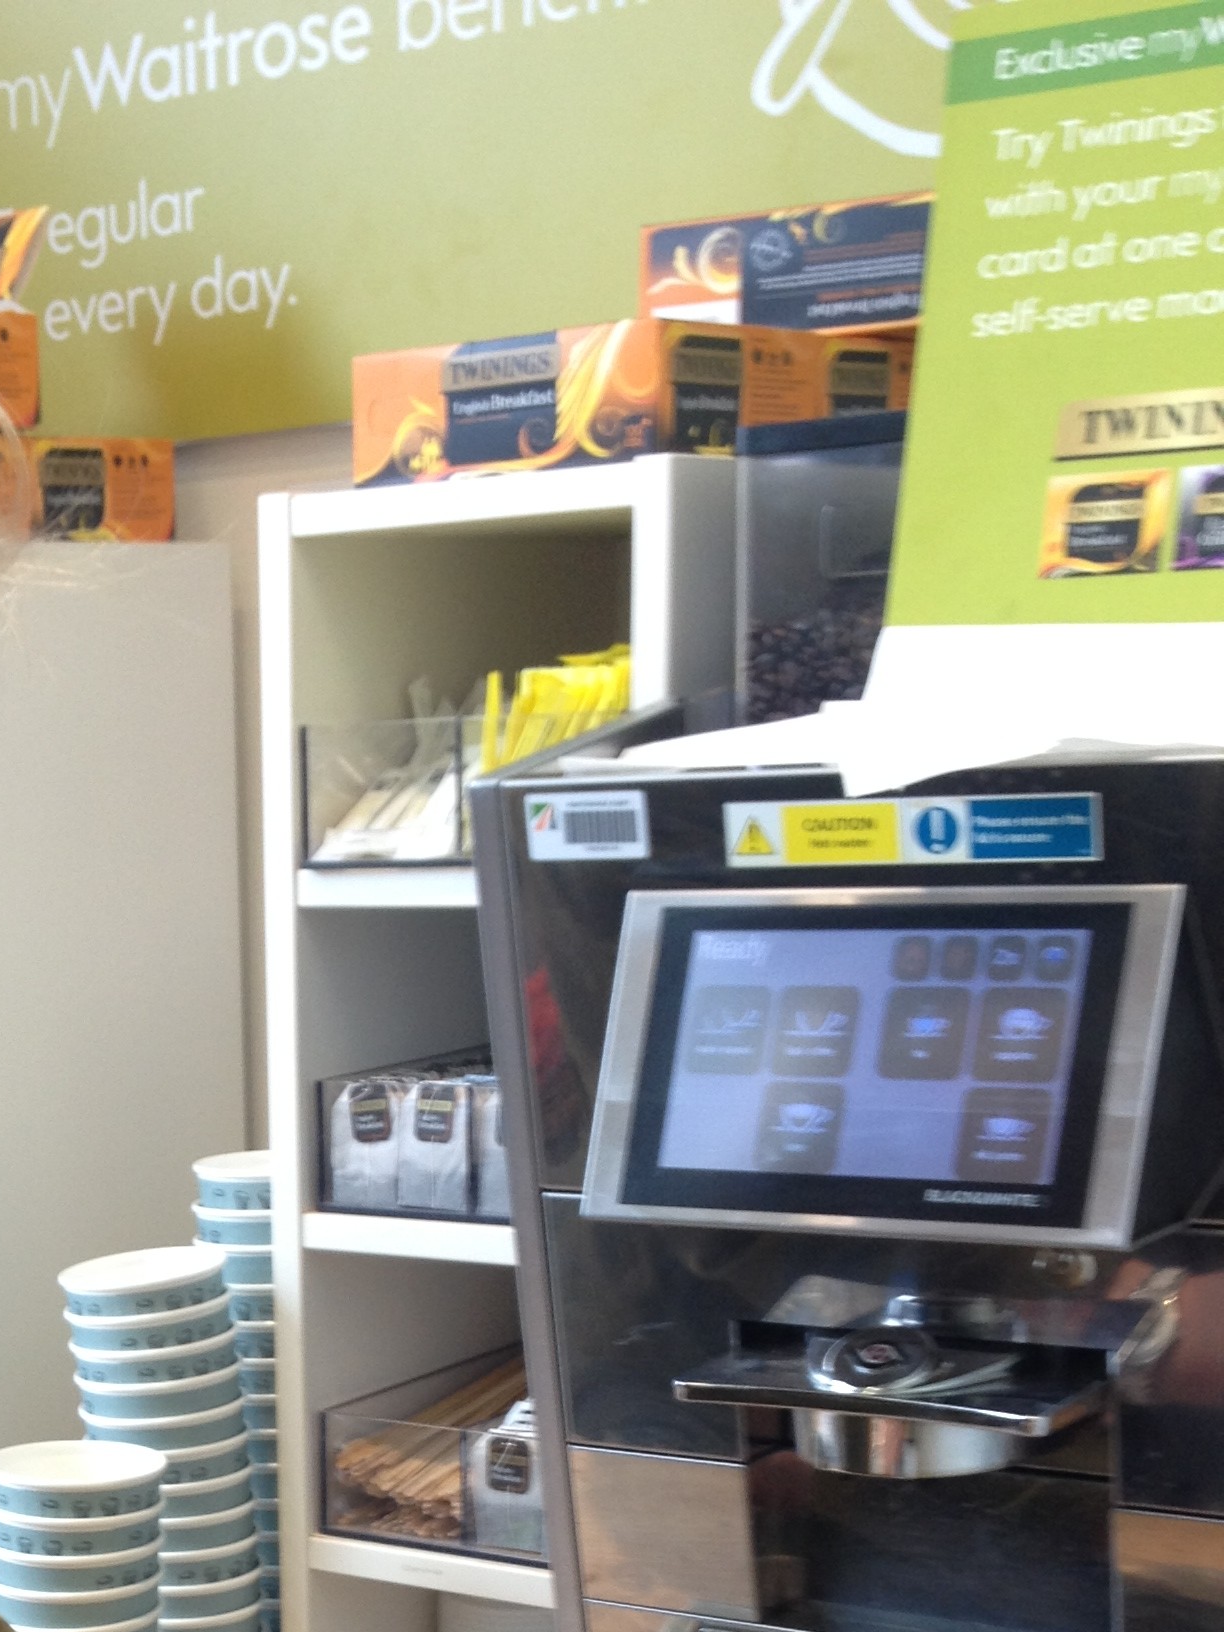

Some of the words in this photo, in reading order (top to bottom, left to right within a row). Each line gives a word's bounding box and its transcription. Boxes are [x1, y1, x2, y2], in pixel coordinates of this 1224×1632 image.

[993, 32, 1146, 80] Exclusive
[992, 127, 1054, 169] Try
[1057, 107, 1216, 152] Twinings
[984, 179, 1067, 219] with
[1071, 175, 1165, 222] your
[47, 181, 205, 269] egular
[976, 235, 1070, 279] card
[1072, 231, 1118, 268] at
[1122, 231, 1202, 264] one
[44, 281, 176, 346] every
[191, 255, 298, 327] day.
[970, 297, 1152, 337] self-serve
[450, 351, 552, 385] TWININGS
[1079, 400, 1224, 444] TWINI
